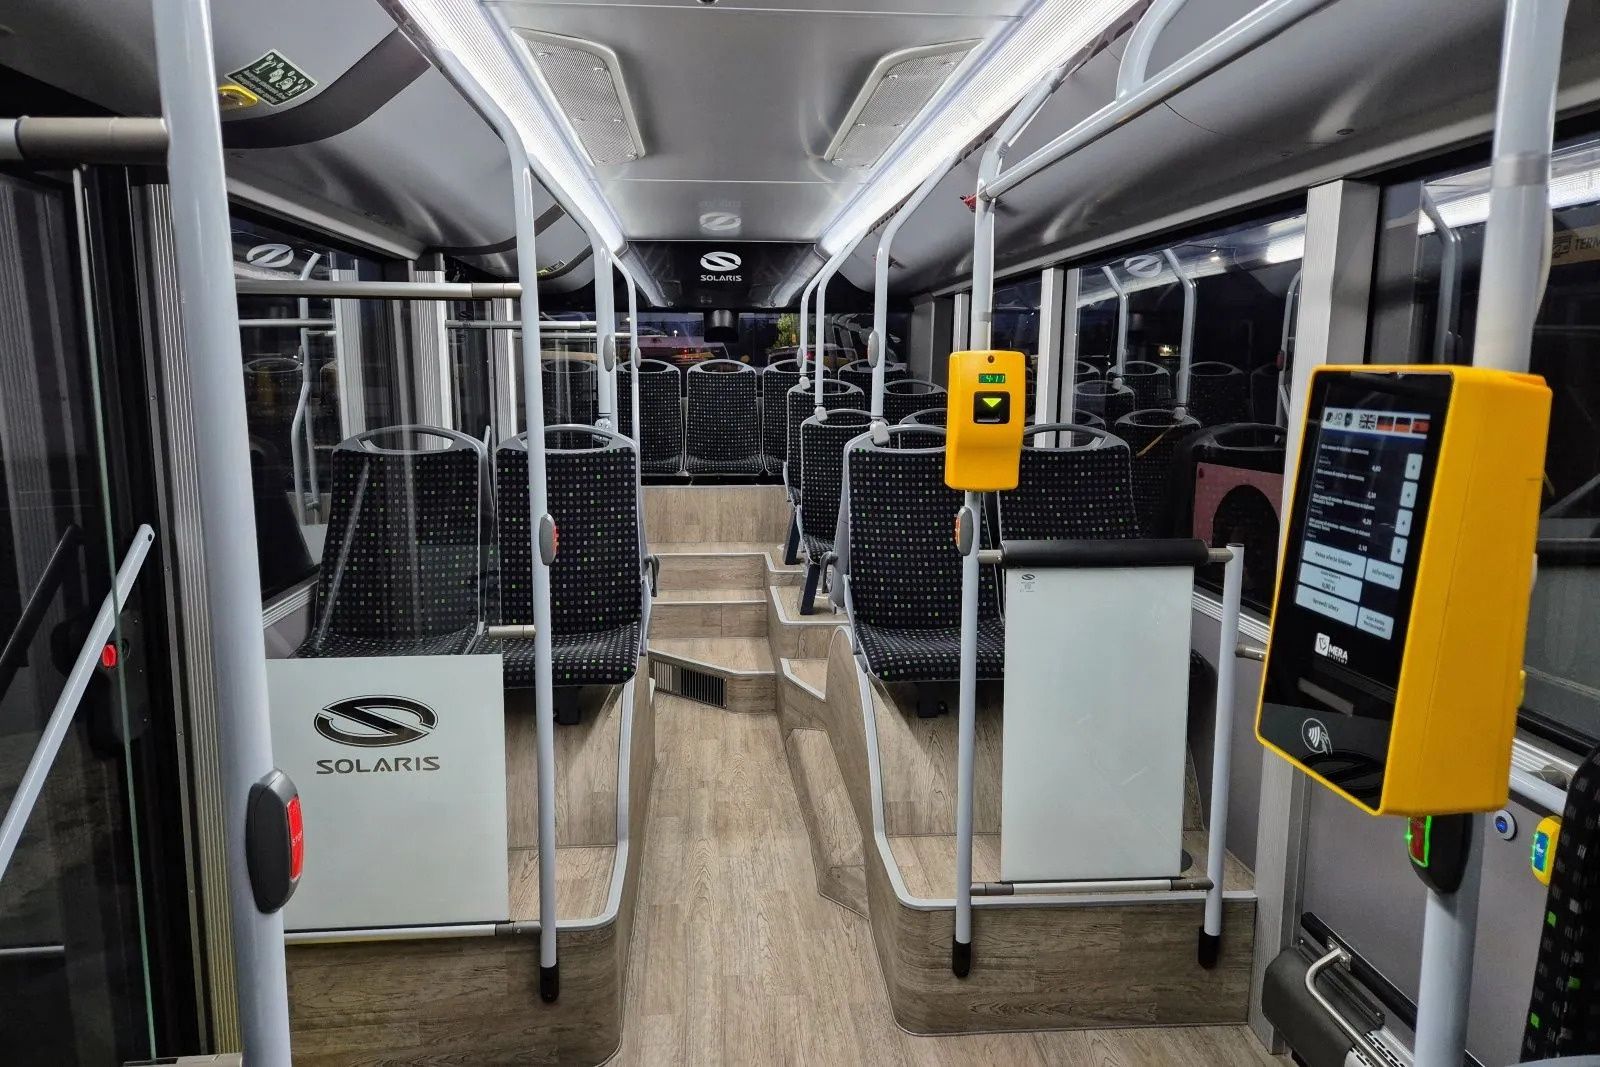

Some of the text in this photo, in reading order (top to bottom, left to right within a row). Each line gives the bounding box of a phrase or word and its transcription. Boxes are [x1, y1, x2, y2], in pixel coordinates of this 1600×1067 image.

[700, 274, 742, 282] SOLARIS
[1329, 643, 1348, 660] MERA
[316, 756, 441, 775] SOLARIS
